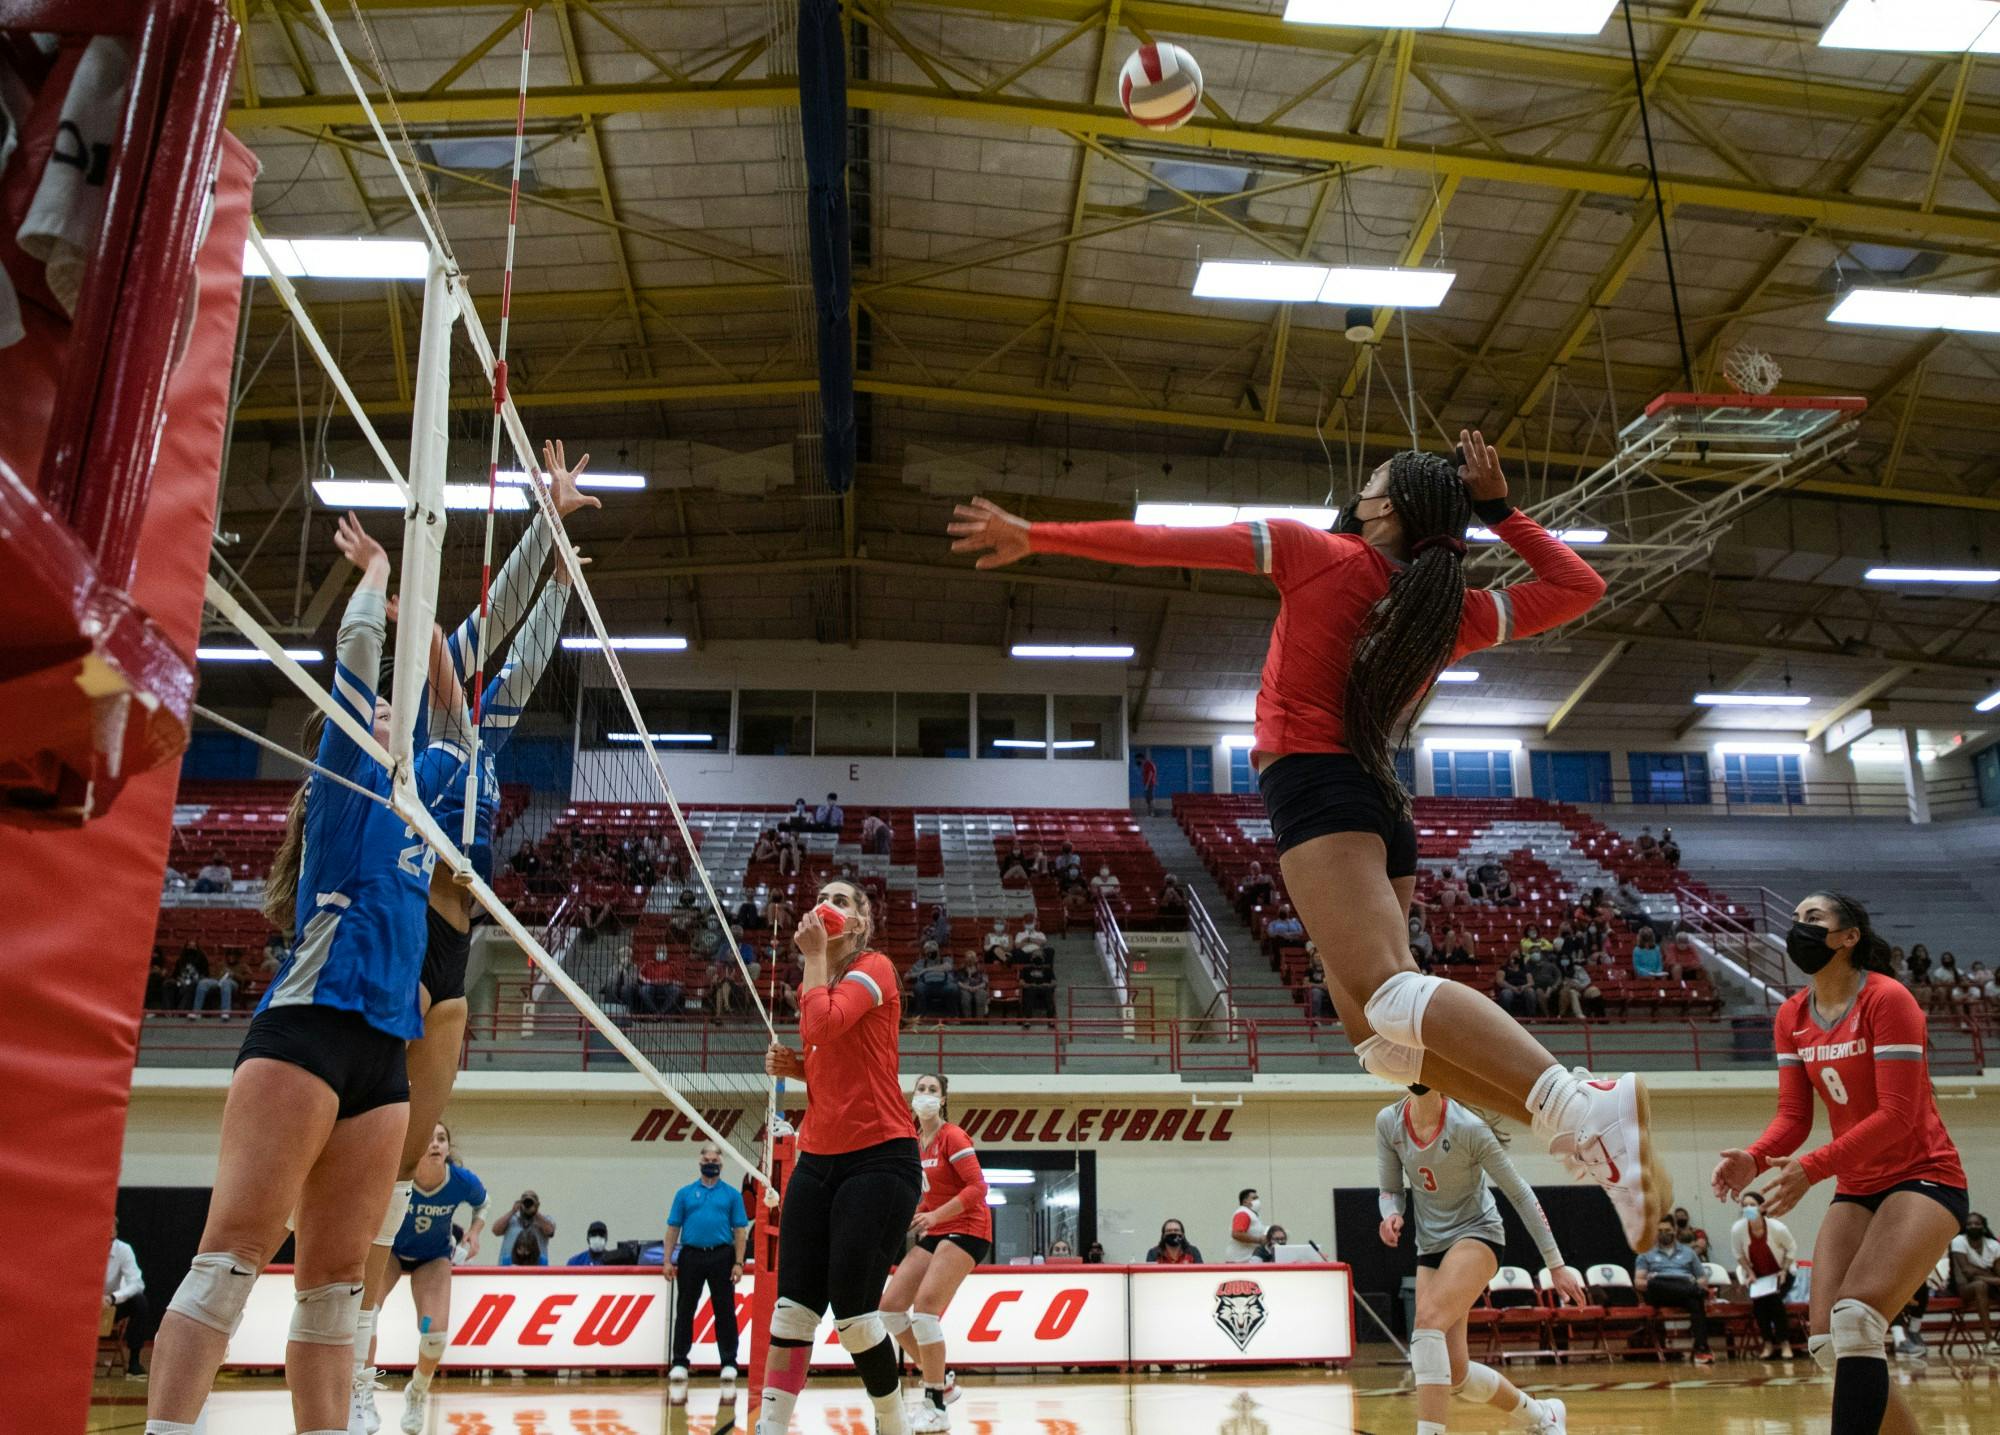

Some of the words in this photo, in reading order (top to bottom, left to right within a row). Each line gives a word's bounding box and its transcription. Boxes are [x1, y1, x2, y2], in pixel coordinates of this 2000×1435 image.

[849, 764, 860, 781] E
[1126, 935, 1158, 944] CESSION
[1160, 935, 1180, 944] AREA
[1820, 1066, 1849, 1105] 8
[630, 1108, 744, 1142] NEW
[957, 1108, 1235, 1143] VOLLEYBALL
[1417, 1166, 1439, 1193] 3
[416, 1204, 456, 1217] FORCE
[414, 1216, 433, 1235] 9
[450, 1294, 656, 1347] NEW
